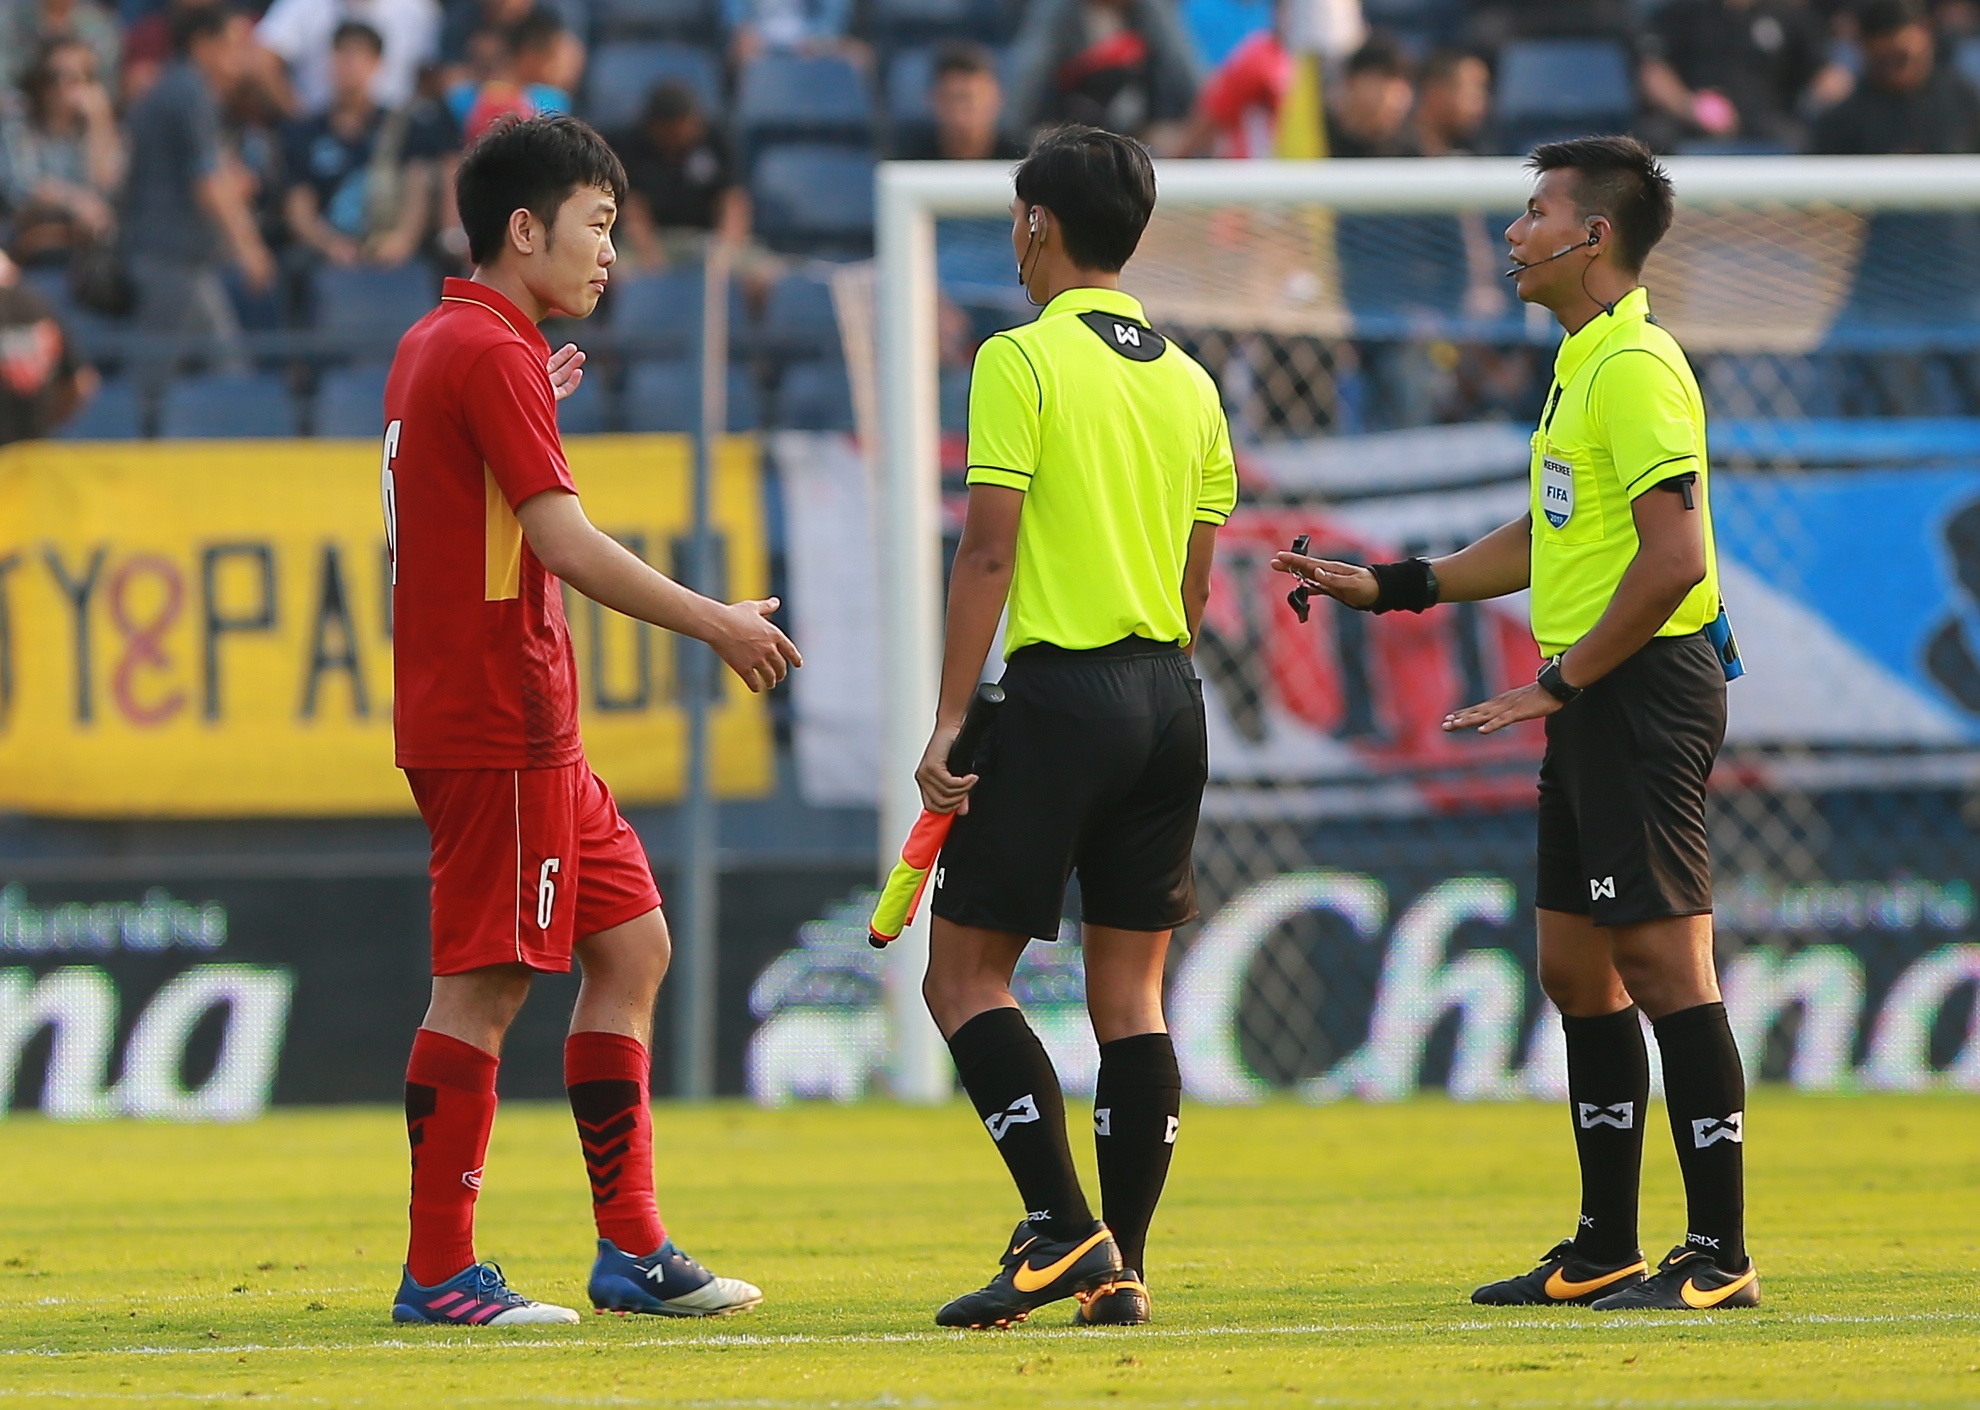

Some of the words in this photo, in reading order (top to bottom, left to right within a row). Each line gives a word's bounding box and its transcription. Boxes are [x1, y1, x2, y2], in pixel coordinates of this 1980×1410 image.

[1543, 460, 1571, 477] REFEREE
[1547, 486, 1568, 502] FIFA
[537, 858, 560, 929] 6
